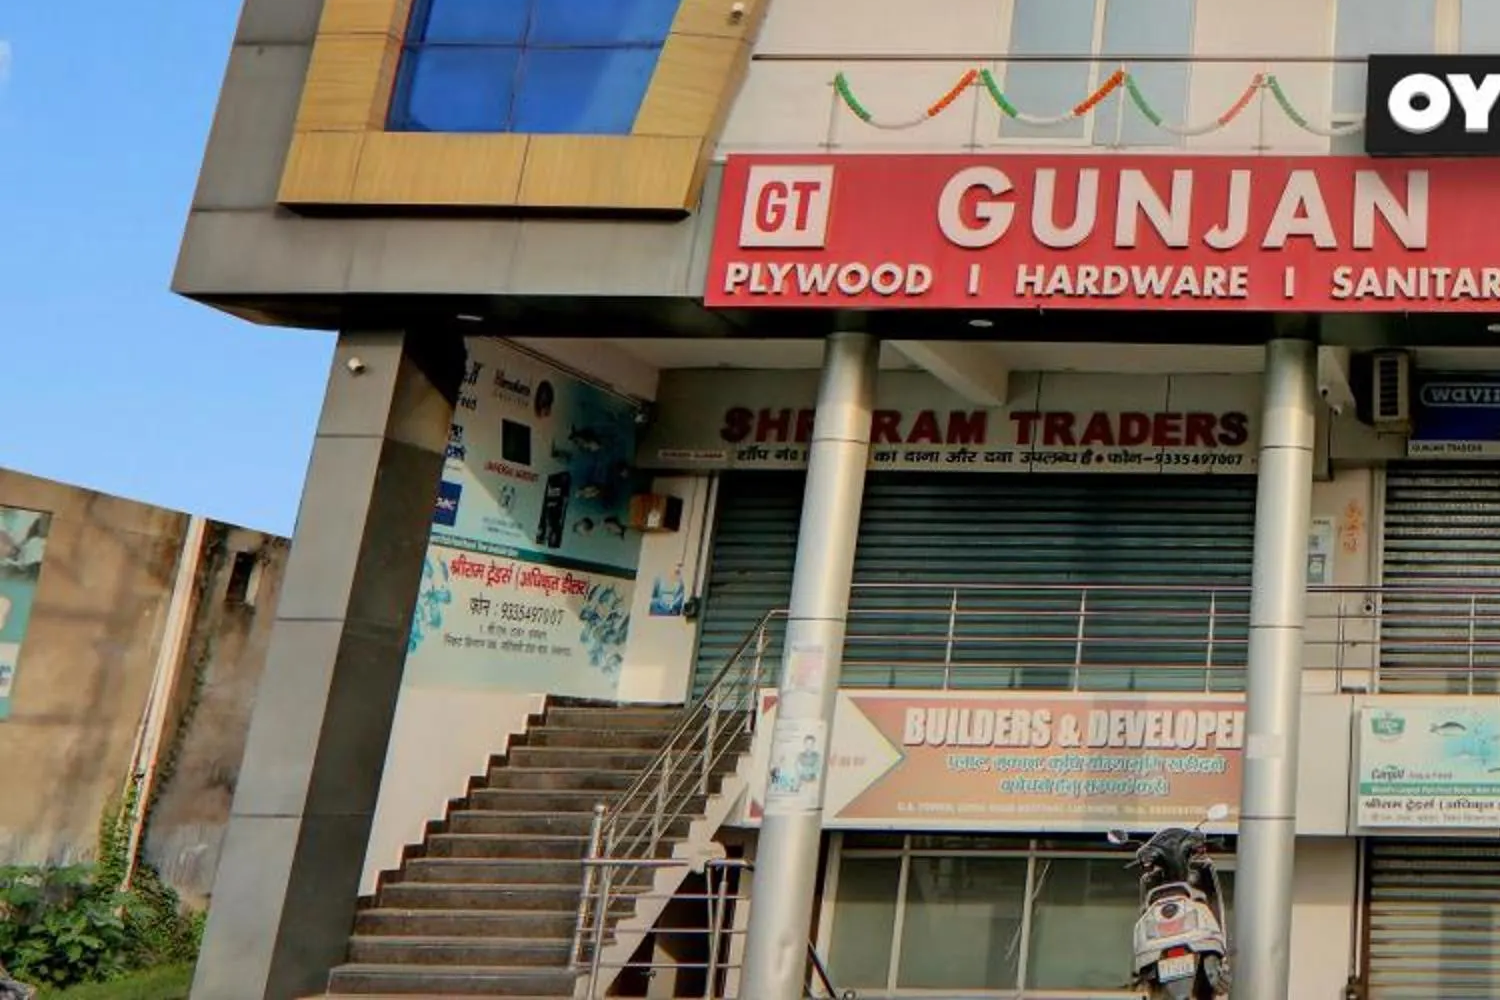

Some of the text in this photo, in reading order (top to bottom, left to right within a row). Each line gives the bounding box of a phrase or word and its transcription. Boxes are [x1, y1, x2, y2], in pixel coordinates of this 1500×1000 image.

[755, 180, 822, 234] GT
[937, 167, 1429, 250] GUNJAN
[724, 263, 933, 298] PLYWOOD
[1015, 264, 1249, 300] HARDWARE
[870, 408, 988, 445] RAM
[1010, 410, 1250, 447] TRADERS
[874, 450, 896, 463] का
[903, 707, 1052, 749] BUILDERS
[1056, 715, 1082, 747] &
